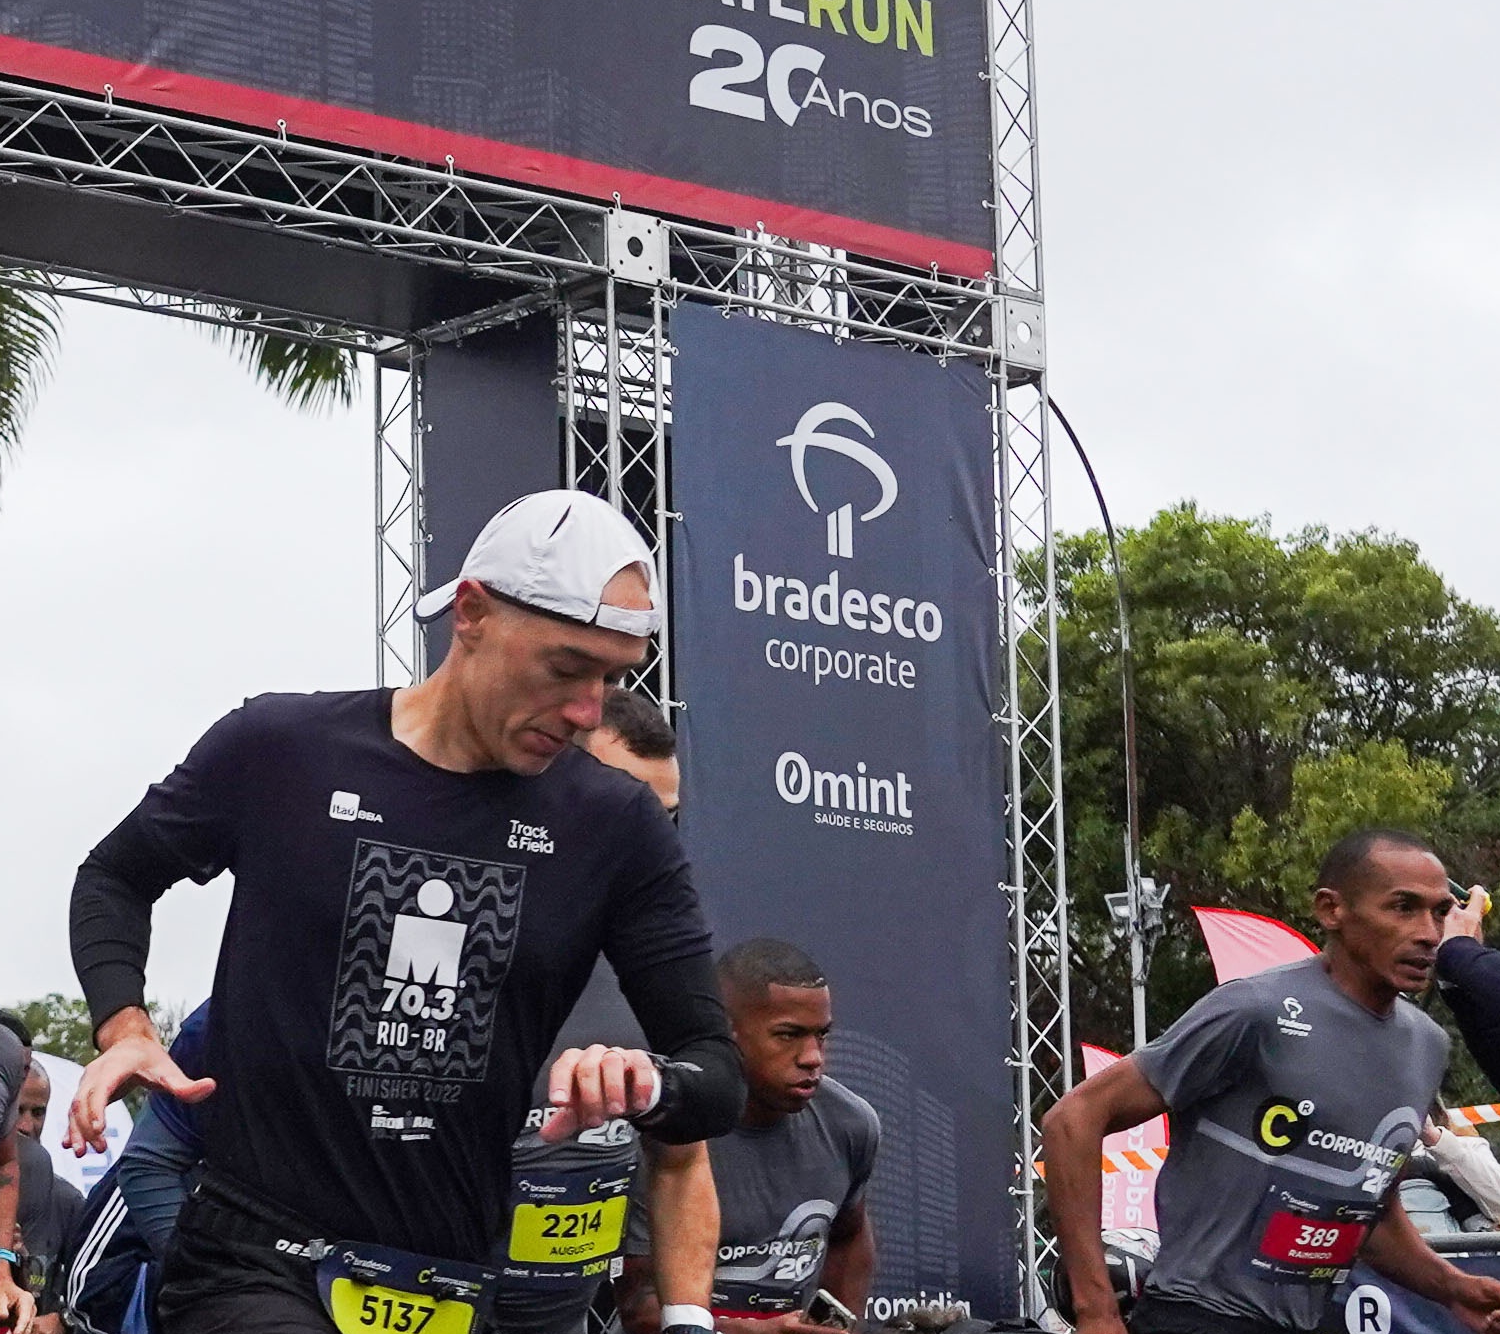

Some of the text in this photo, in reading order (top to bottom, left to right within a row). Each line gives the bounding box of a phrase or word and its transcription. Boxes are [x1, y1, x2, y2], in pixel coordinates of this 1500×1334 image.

[734, 553, 943, 642] bradesco
[765, 638, 916, 689] corporate
[775, 751, 913, 818] Omint
[510, 819, 548, 839] Track
[815, 812, 914, 836] SAÚDE E SEGUROS
[507, 836, 554, 854] & Field
[346, 1076, 462, 1103] FINISHER 2022
[541, 1209, 602, 1238] 2214
[1295, 1225, 1340, 1247] 389
[549, 1242, 595, 1256] AUGUSTO
[360, 1295, 435, 1334] 5137
